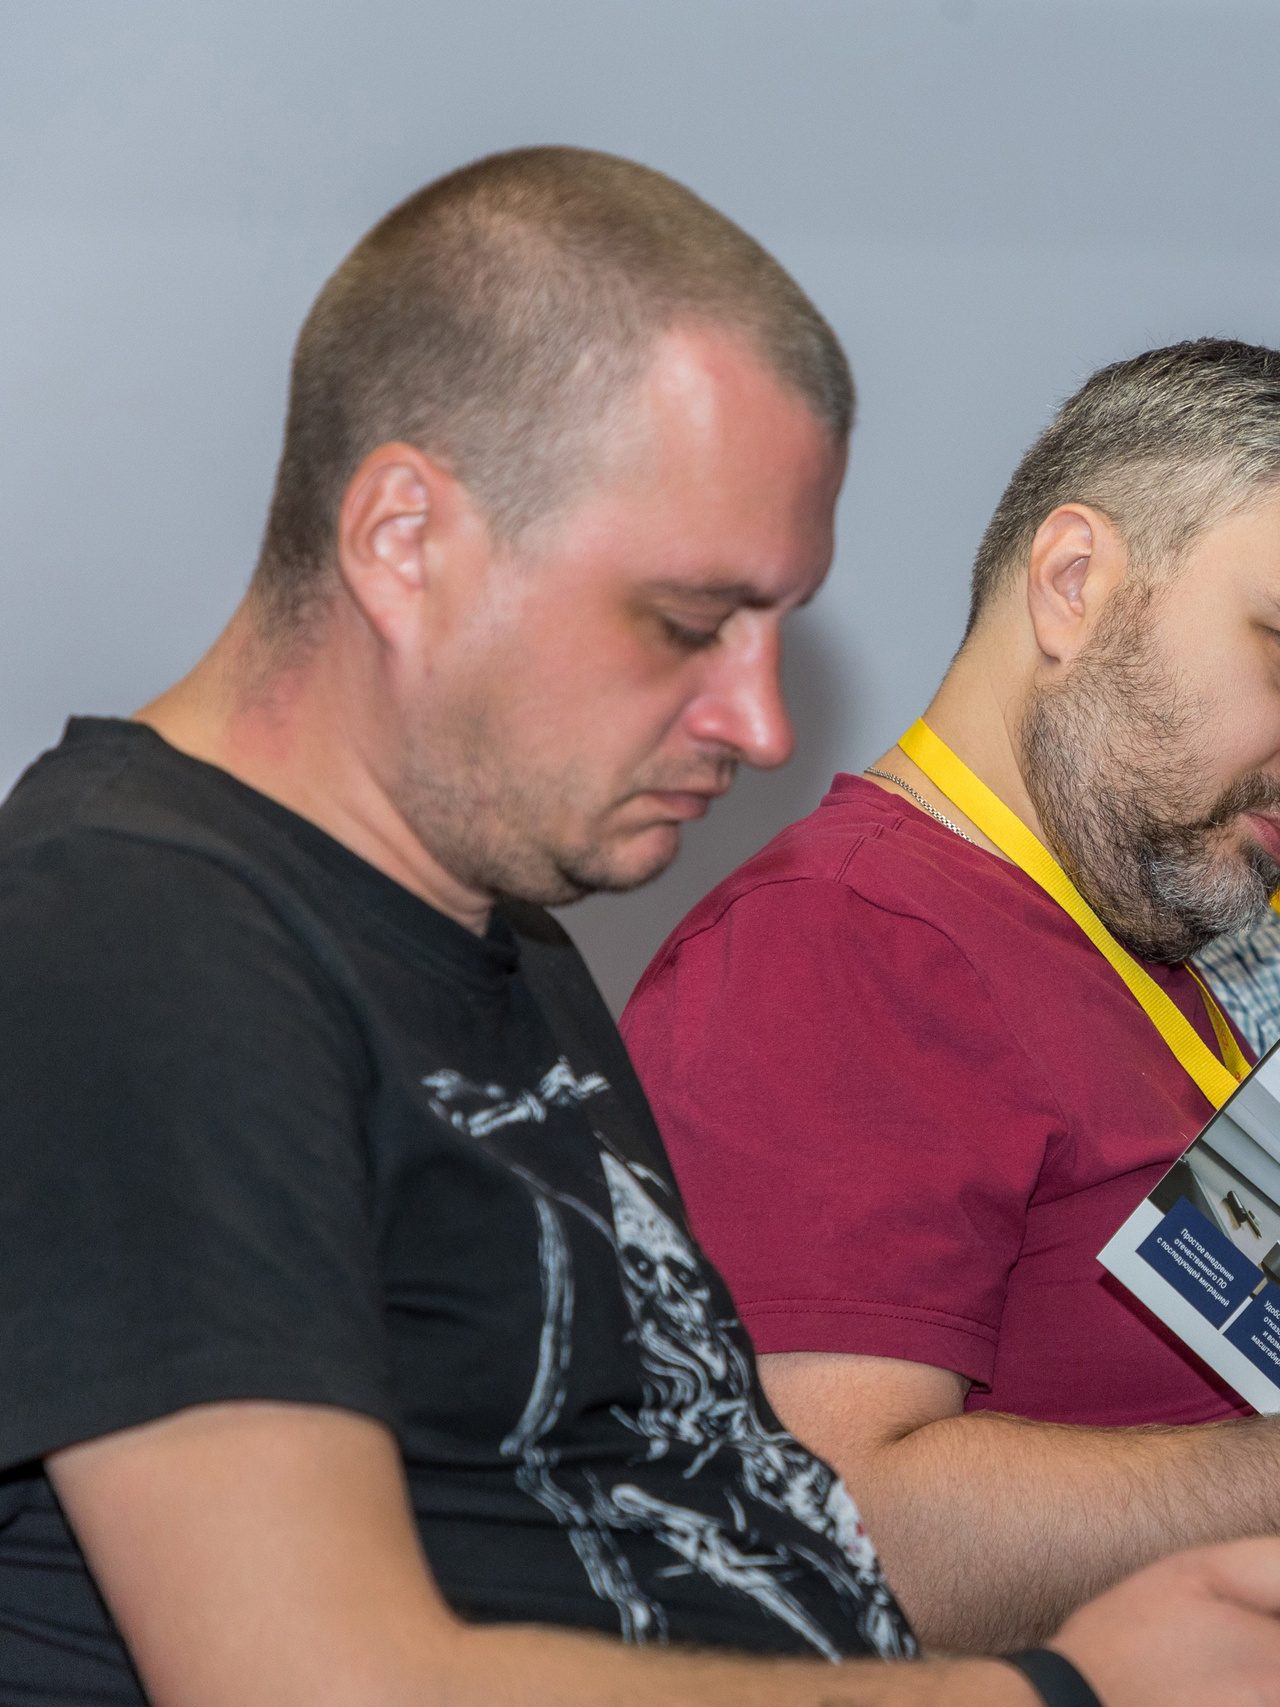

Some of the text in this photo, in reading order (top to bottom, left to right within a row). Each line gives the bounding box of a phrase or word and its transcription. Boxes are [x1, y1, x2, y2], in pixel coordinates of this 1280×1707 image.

[1160, 1241, 1200, 1280] последующей
[1198, 1276, 1230, 1308] миграцией
[1174, 1238, 1228, 1289] отечественного ПО
[1180, 1228, 1235, 1282] Простое внедрение
[1262, 1330, 1268, 1338] и
